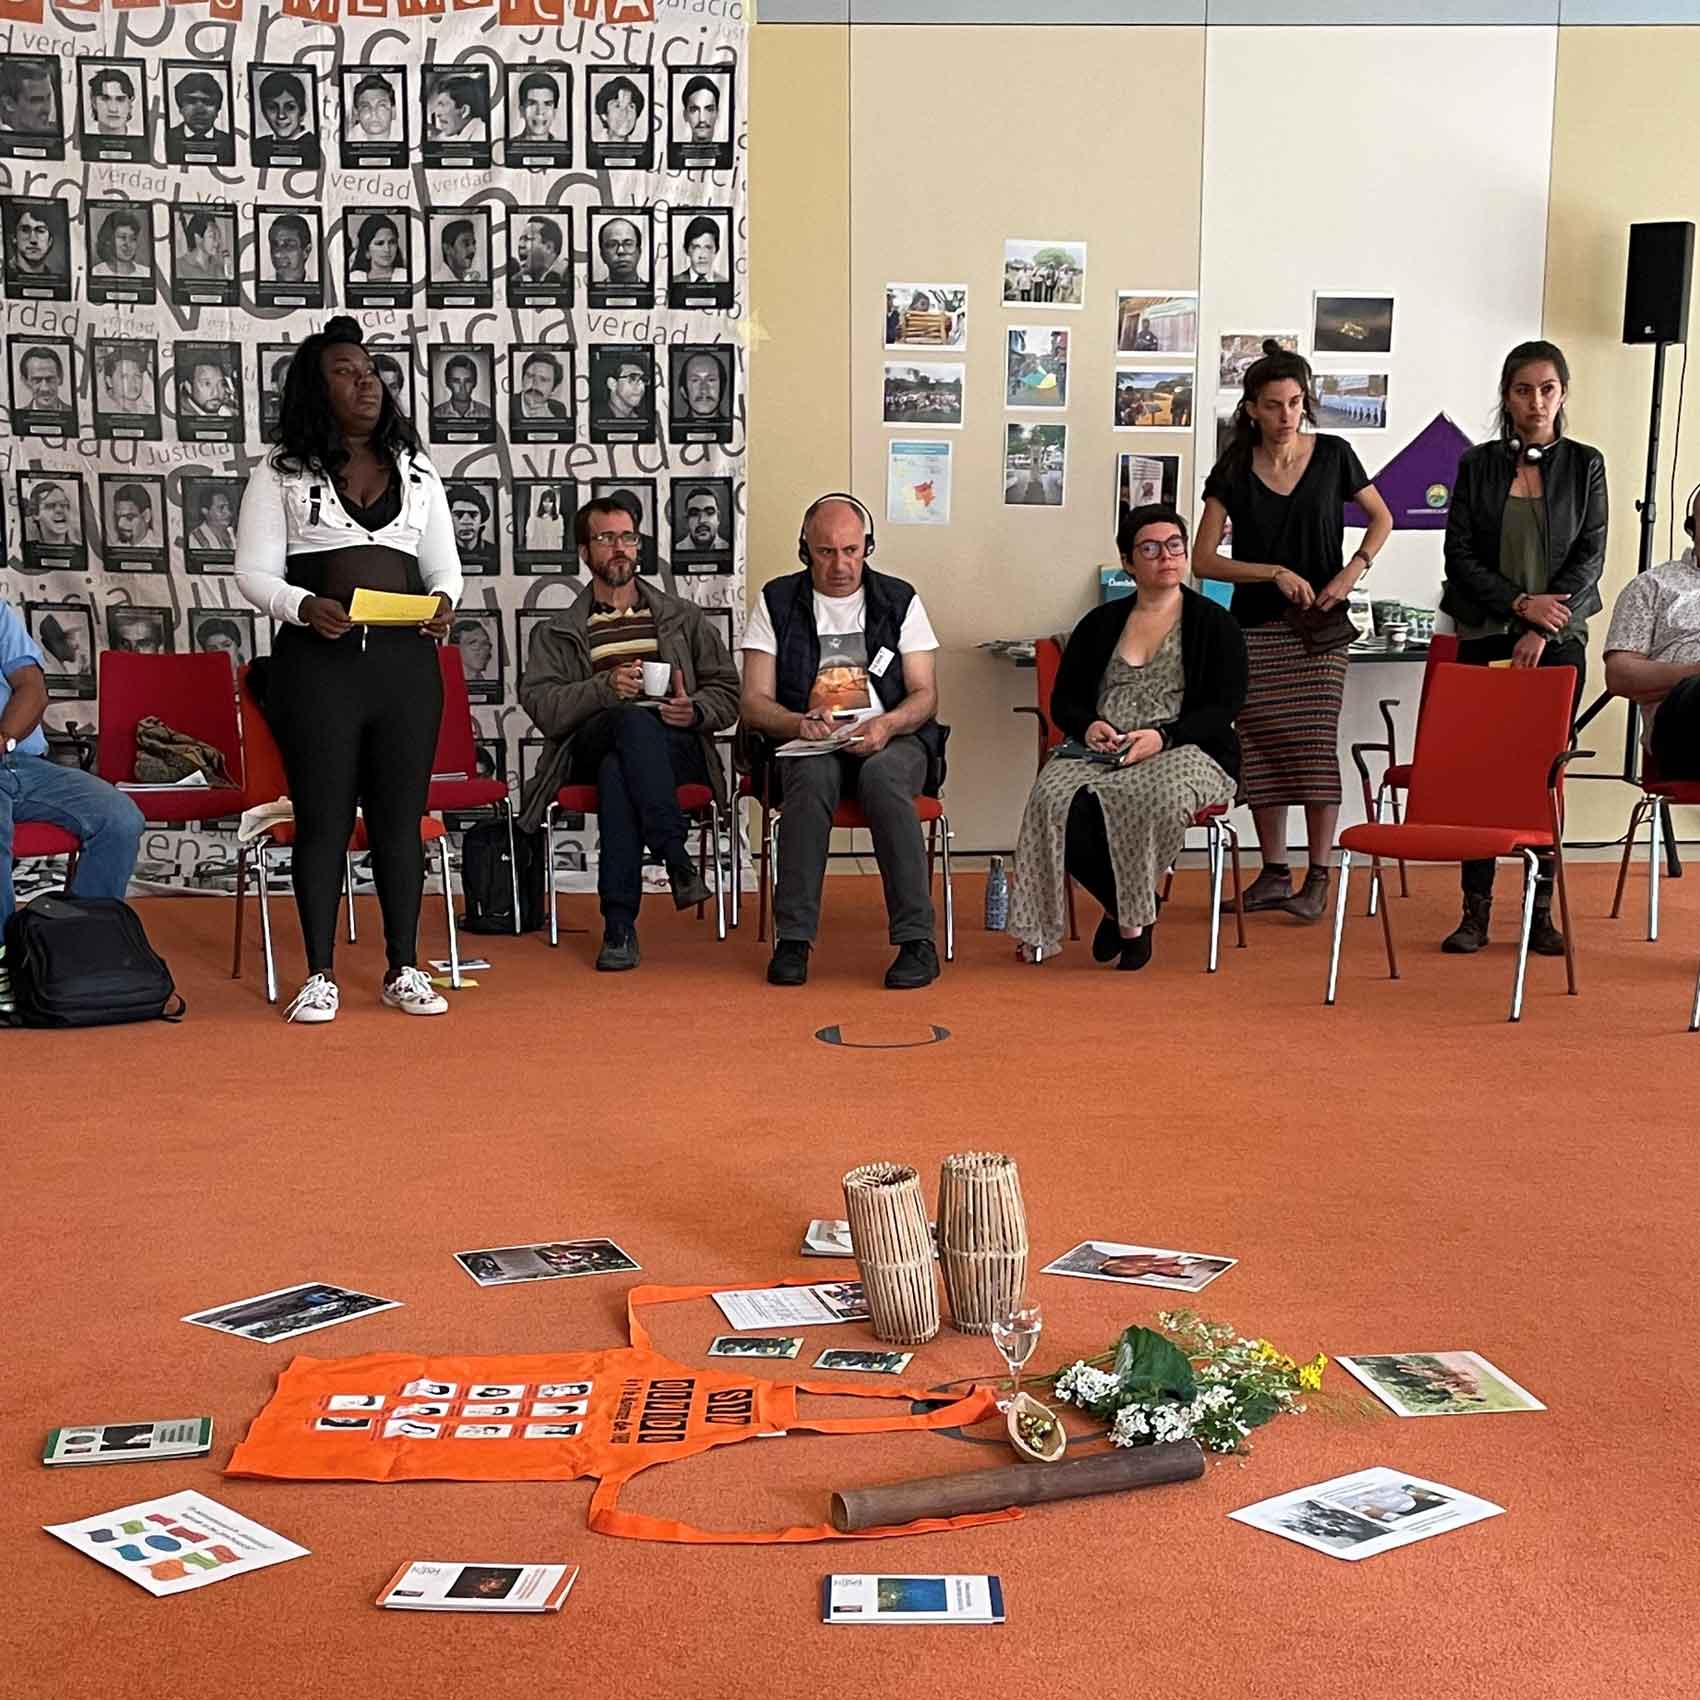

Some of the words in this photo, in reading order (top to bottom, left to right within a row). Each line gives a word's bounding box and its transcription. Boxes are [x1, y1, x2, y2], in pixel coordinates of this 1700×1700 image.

[330, 171, 412, 201] verdad
[432, 170, 494, 193] verdad
[587, 313, 689, 346] verdad
